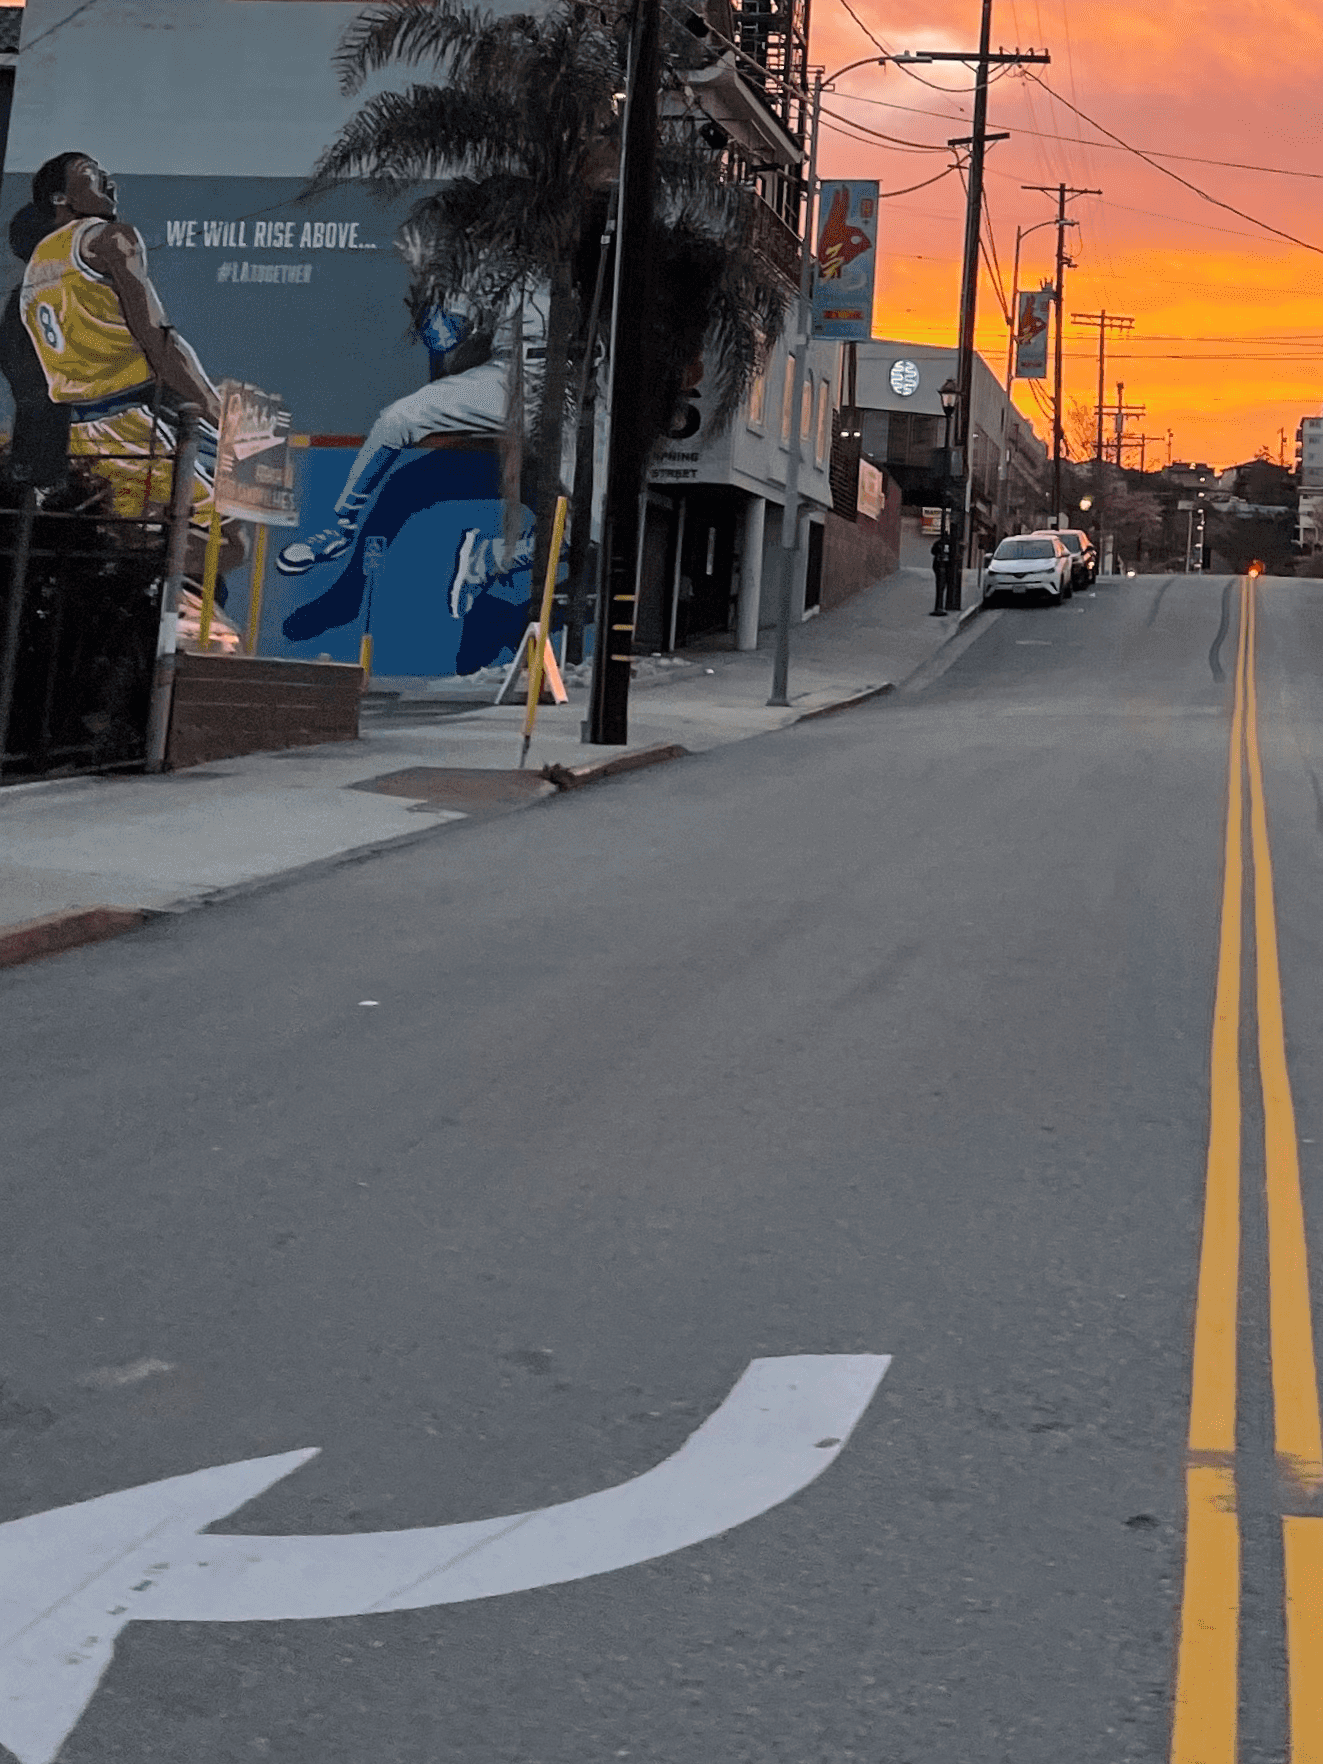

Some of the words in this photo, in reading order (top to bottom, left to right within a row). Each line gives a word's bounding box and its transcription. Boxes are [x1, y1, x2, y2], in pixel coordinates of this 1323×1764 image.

[166, 220, 198, 247] WE
[203, 220, 248, 247] WILL
[253, 221, 296, 248] RISE
[300, 221, 377, 249] ABOVE...
[39, 304, 60, 350] 8
